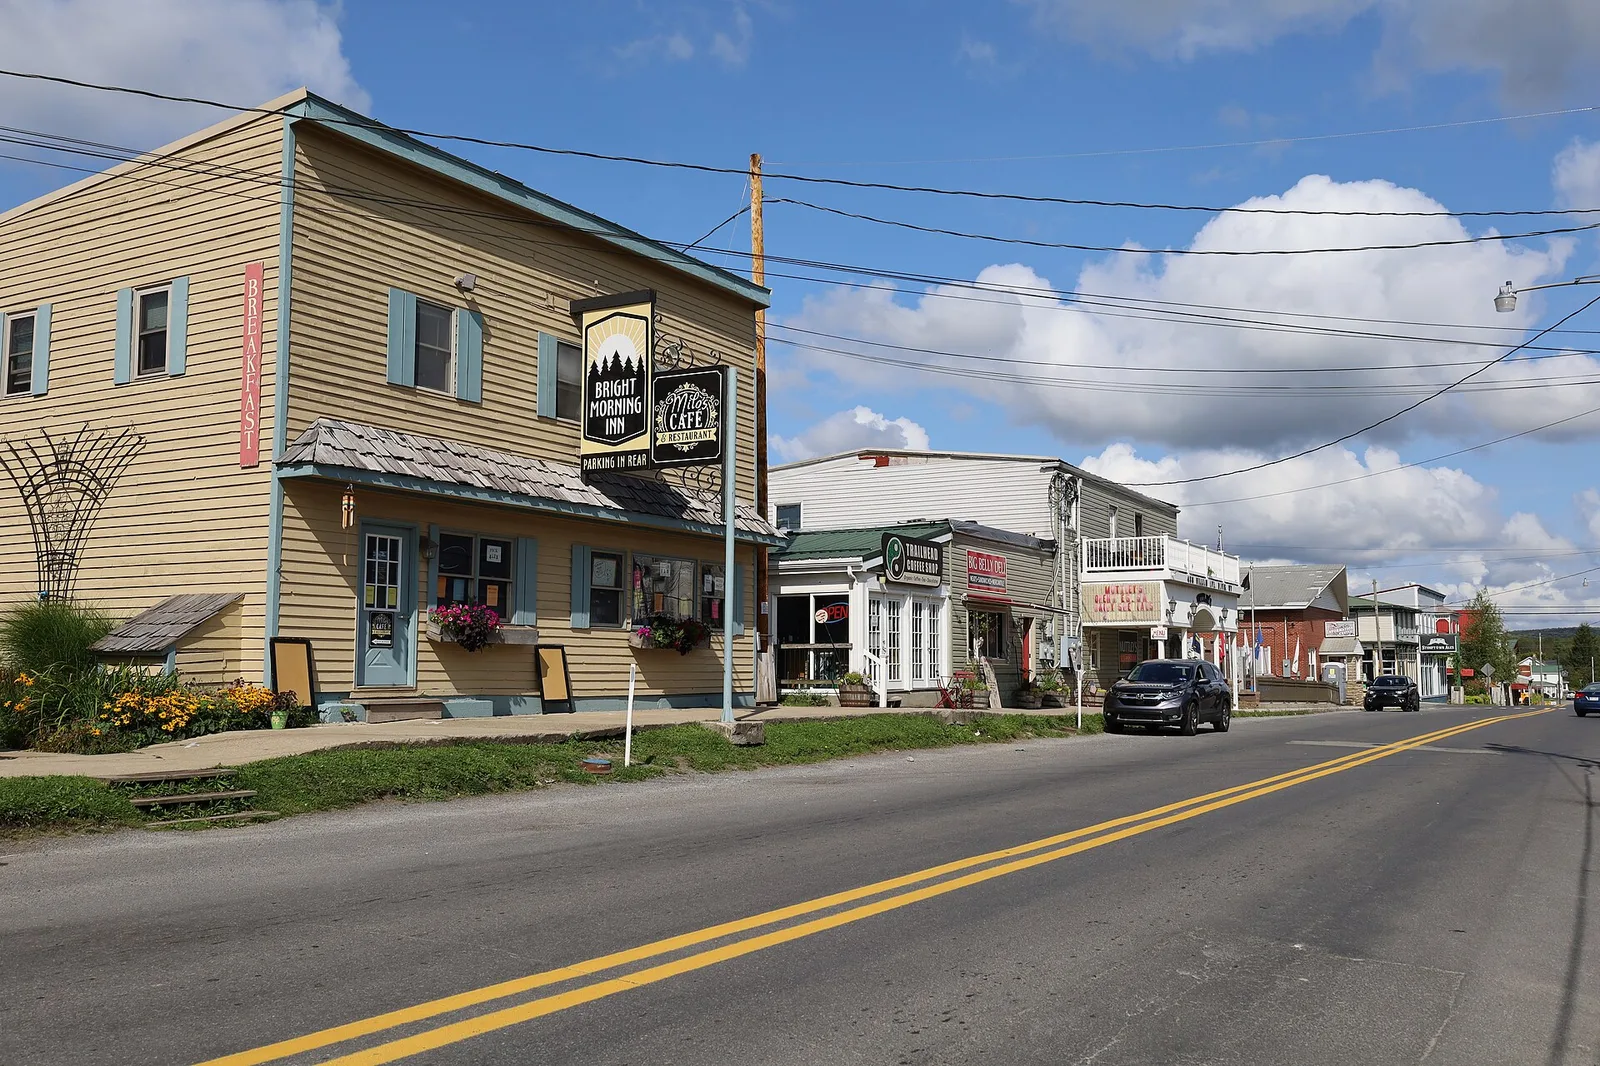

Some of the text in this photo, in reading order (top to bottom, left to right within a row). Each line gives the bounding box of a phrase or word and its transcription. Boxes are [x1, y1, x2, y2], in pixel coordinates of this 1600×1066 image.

[244, 278, 258, 450] BREAKFAST
[595, 377, 637, 398] BRIGHT
[589, 396, 642, 418] MORNING
[665, 392, 709, 413] Milo's
[605, 416, 625, 436] INN
[660, 431, 712, 443] & RESTAURANT
[583, 453, 647, 471] PARKING IN REAR
[906, 543, 938, 561] TRAILHEAD
[906, 559, 938, 574] COFFEE SHOP
[968, 555, 1006, 574] BIG BELLY DELI
